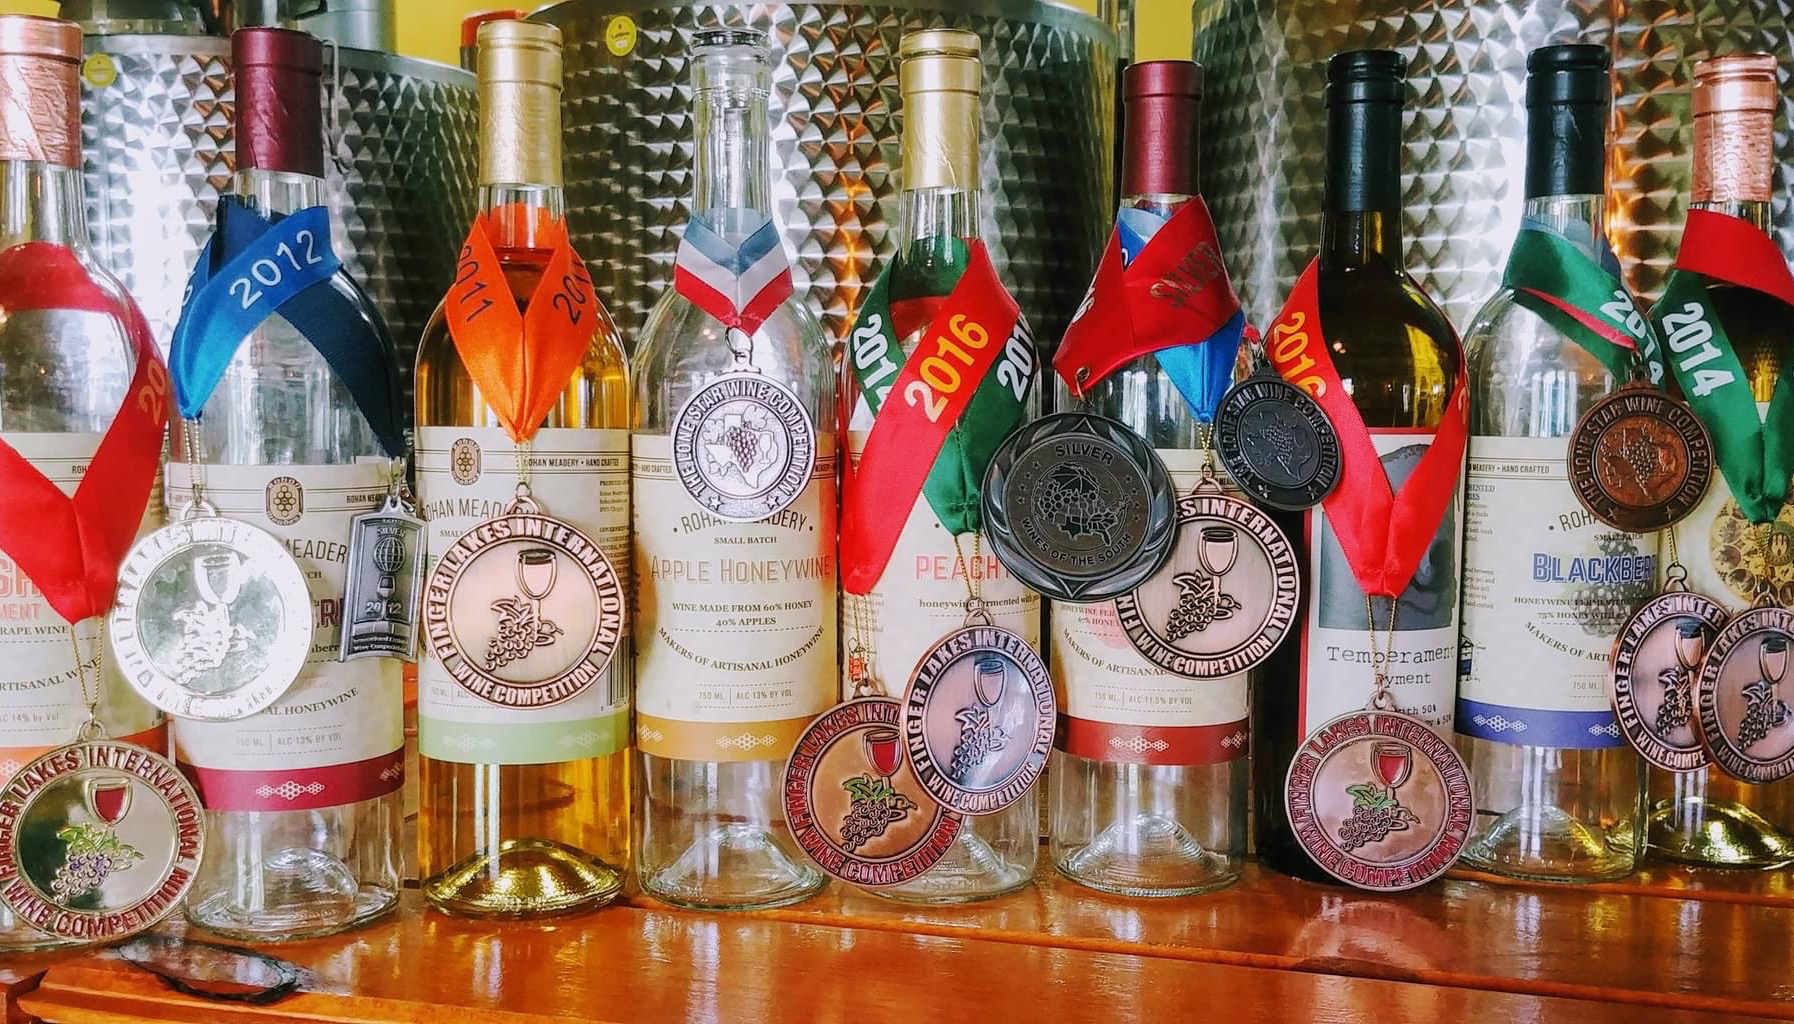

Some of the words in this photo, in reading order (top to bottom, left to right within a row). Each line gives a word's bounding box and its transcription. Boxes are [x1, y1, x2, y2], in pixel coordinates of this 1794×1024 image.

[230, 230, 323, 309] 2012
[997, 323, 1034, 402] 201
[1661, 302, 1736, 397] 2014
[905, 313, 989, 423] 2016
[688, 387, 725, 419] STAR
[724, 380, 768, 397] WINE
[1254, 384, 1292, 401] WINE
[1625, 397, 1663, 412] WINE
[1586, 404, 1621, 434] STAR
[677, 422, 695, 463] LONE
[769, 392, 810, 496] COMPETITION
[1055, 443, 1114, 465] SILVER
[1575, 436, 1593, 474] LONE
[1668, 408, 1708, 505] COMPETITION
[72, 465, 90, 474] ROH
[549, 458, 578, 467] MEADERY
[1501, 465, 1519, 473] HAND
[1520, 465, 1550, 474] CRAFTED
[683, 466, 707, 497] THE
[1580, 478, 1603, 508] THE
[681, 511, 731, 534] ROHA
[714, 537, 746, 545] SMALL
[747, 536, 777, 544] BATCH
[1021, 517, 1049, 553] WINES
[1051, 549, 1067, 563] OF
[1071, 555, 1094, 566] THE
[1099, 534, 1133, 563] SOUTH
[650, 555, 711, 584] APPLE
[720, 555, 831, 585] HONEYWINE
[1202, 499, 1295, 631] INTERNATIONAL
[1532, 552, 1656, 583] BLACKBER
[429, 573, 457, 661] FINGER
[450, 520, 511, 570] LAKES
[515, 518, 619, 655] INTERNATIONAL
[672, 602, 697, 612] WINE
[699, 603, 729, 612] MADE
[731, 603, 761, 612] FROM
[763, 602, 783, 612] 60%
[784, 600, 813, 610] HONEY
[0, 626, 32, 635] RAPE
[34, 625, 69, 635] WINE
[716, 618, 737, 628] 40%
[738, 616, 776, 626] APPLES
[1524, 621, 1568, 653] MAKERS
[1569, 647, 1585, 658] OF
[658, 627, 693, 660] MAKERS
[695, 655, 710, 666] OF
[711, 660, 773, 672] ARTISANAL
[775, 625, 824, 666] HONEYWINE
[1063, 628, 1091, 661] MAKERS
[1092, 657, 1104, 667] OF
[1136, 633, 1173, 666] WINE
[1173, 634, 1274, 677] COMPETITION
[1617, 650, 1638, 729] FINGER
[1629, 598, 1672, 648] LAKES
[0, 675, 64, 691] RTISANAL
[453, 662, 493, 699] WINE
[493, 662, 599, 706] COMPETITION
[736, 691, 749, 700] ALC
[752, 690, 768, 699] 13%
[769, 690, 779, 698] BY
[781, 688, 792, 697] VOL
[1374, 672, 1432, 689] yment
[1700, 664, 1720, 743] FINGER
[1712, 613, 1757, 662] LAKES
[284, 687, 360, 716] HONEYWINE
[907, 688, 930, 773] FINGER
[920, 633, 972, 686] LAKES
[975, 629, 1053, 754] INTERNATIONAL
[1128, 695, 1143, 704] ALC
[1169, 697, 1178, 705] BY
[1180, 697, 1192, 705] VOL
[277, 736, 293, 746] ALC
[315, 735, 326, 744] BY
[329, 732, 343, 742] VOL
[1635, 730, 1665, 763] WINE
[787, 755, 813, 830] FINGER
[805, 705, 860, 754] LAKES
[1289, 755, 1320, 824] FINGER
[1311, 716, 1370, 755] LAKES
[1374, 715, 1471, 832] INTERNATIONAL
[1717, 744, 1745, 774] WINE
[927, 773, 959, 805] WINE
[960, 762, 1039, 811] COMPETITION
[11, 749, 83, 801] LAKES
[87, 746, 200, 864] INTERNATIONAL
[801, 826, 845, 874] WINE
[845, 816, 960, 884] COMPETITION
[1299, 823, 1341, 869] WINE
[1340, 833, 1460, 887] COMPETITION
[4, 878, 56, 929] WINE
[54, 866, 189, 937] COMPETITION
